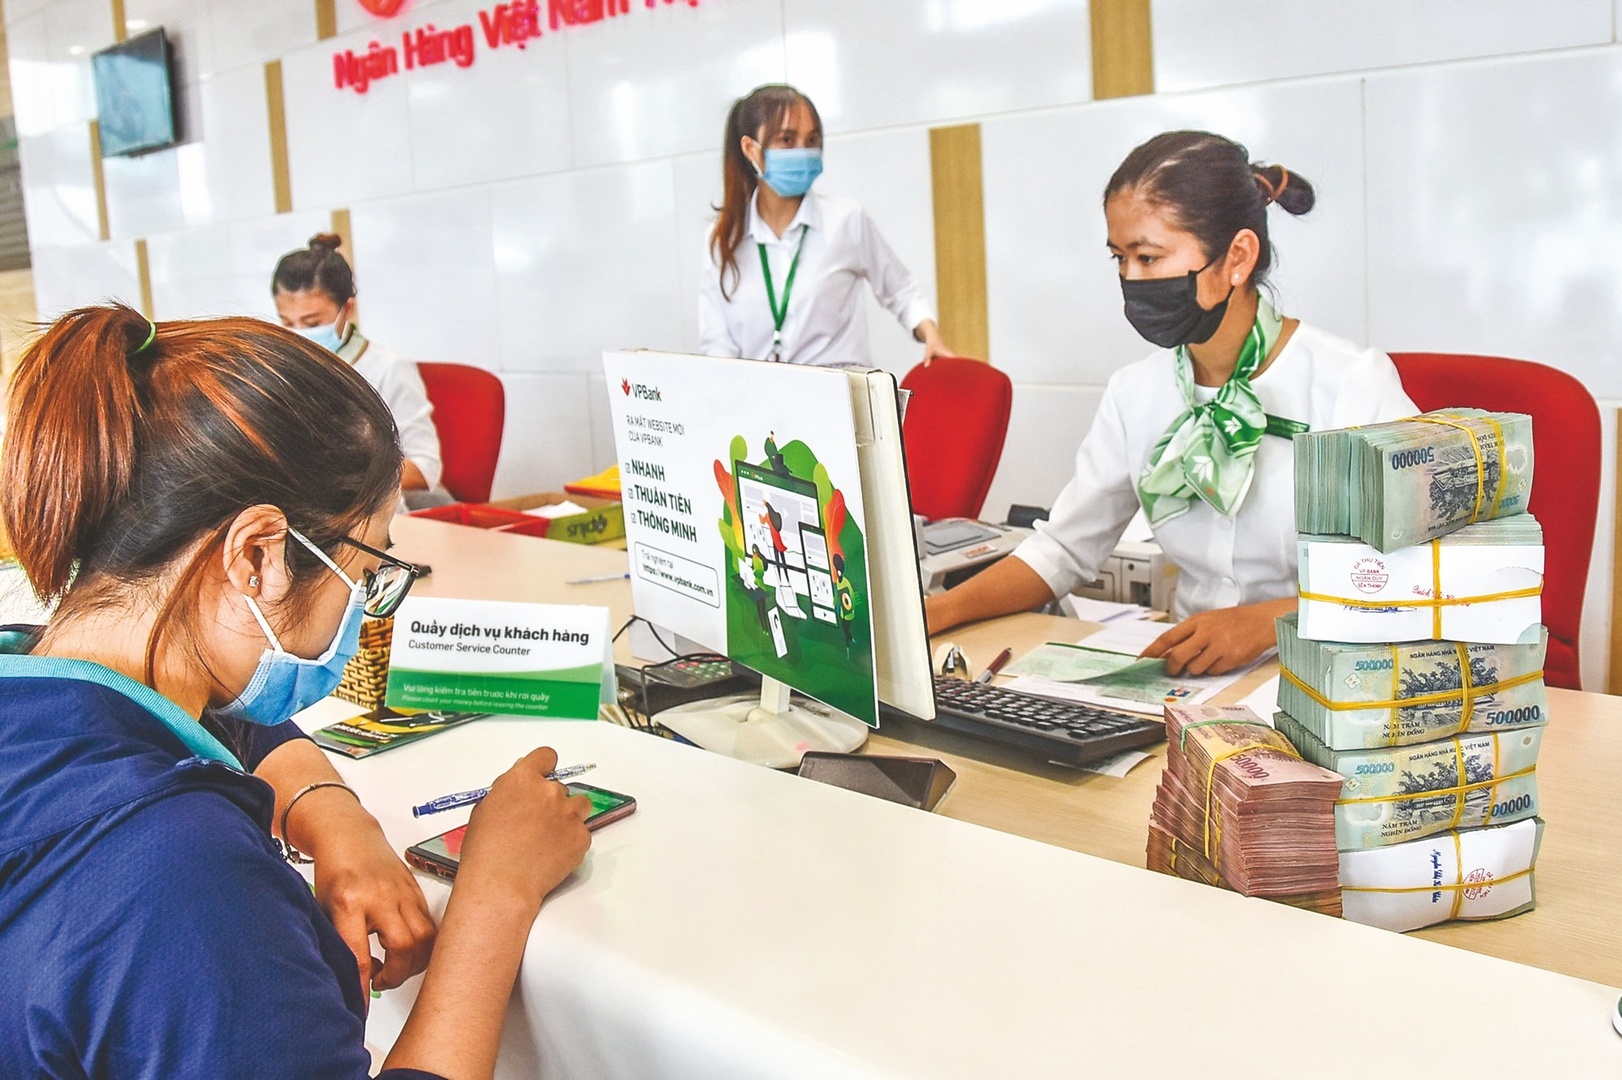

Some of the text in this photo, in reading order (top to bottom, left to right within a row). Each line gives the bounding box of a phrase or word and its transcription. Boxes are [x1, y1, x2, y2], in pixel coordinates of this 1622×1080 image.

[333, 41, 397, 93] Ngân
[403, 24, 473, 67] Hàng
[632, 383, 662, 401] VPBank
[647, 419, 673, 433] WEBSITE
[640, 433, 663, 447] VPBANK
[1392, 446, 1434, 471] 500000
[631, 459, 665, 482] NHANH
[637, 509, 697, 543] THÔNG MINH
[450, 623, 480, 638] dịch
[484, 628, 501, 641] vụ
[504, 626, 549, 640] khách
[552, 629, 589, 646] hàng
[408, 639, 531, 655] Customer Service Counter
[1354, 658, 1393, 671] 500000
[1485, 704, 1540, 726] 500000
[1354, 762, 1394, 775] 500000
[1481, 794, 1531, 818] 500000
